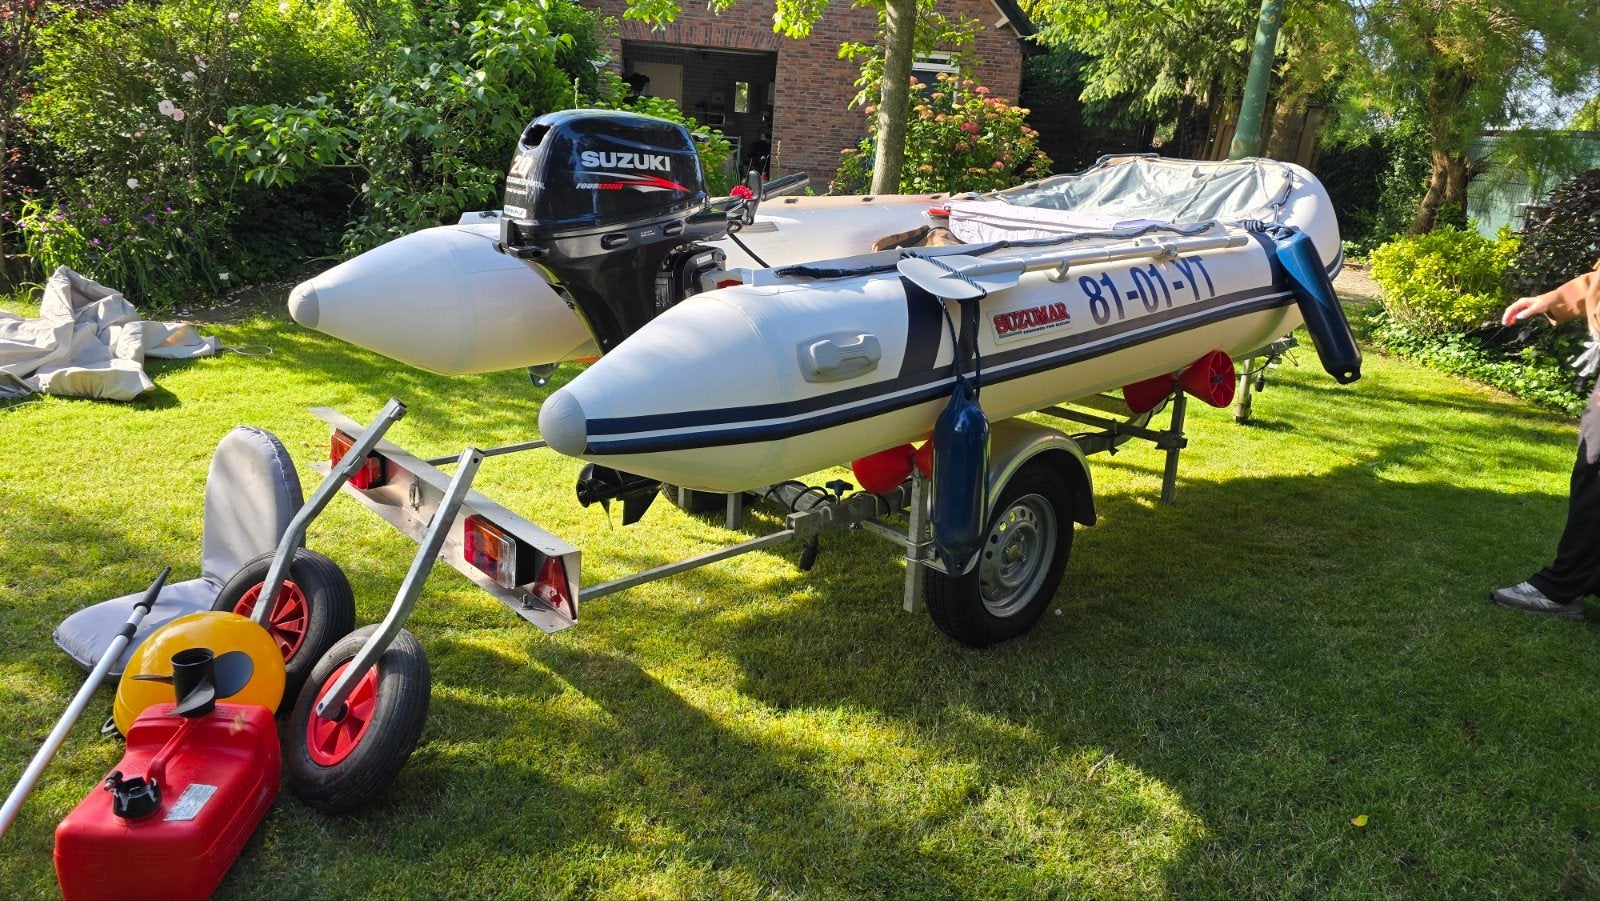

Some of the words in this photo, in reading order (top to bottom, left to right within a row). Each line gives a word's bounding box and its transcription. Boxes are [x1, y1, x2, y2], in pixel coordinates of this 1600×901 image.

[510, 154, 534, 175] 20
[581, 151, 671, 172] SUZUKI
[1078, 255, 1216, 325] 81-01-YT
[993, 302, 1071, 334] SUZUMAR
